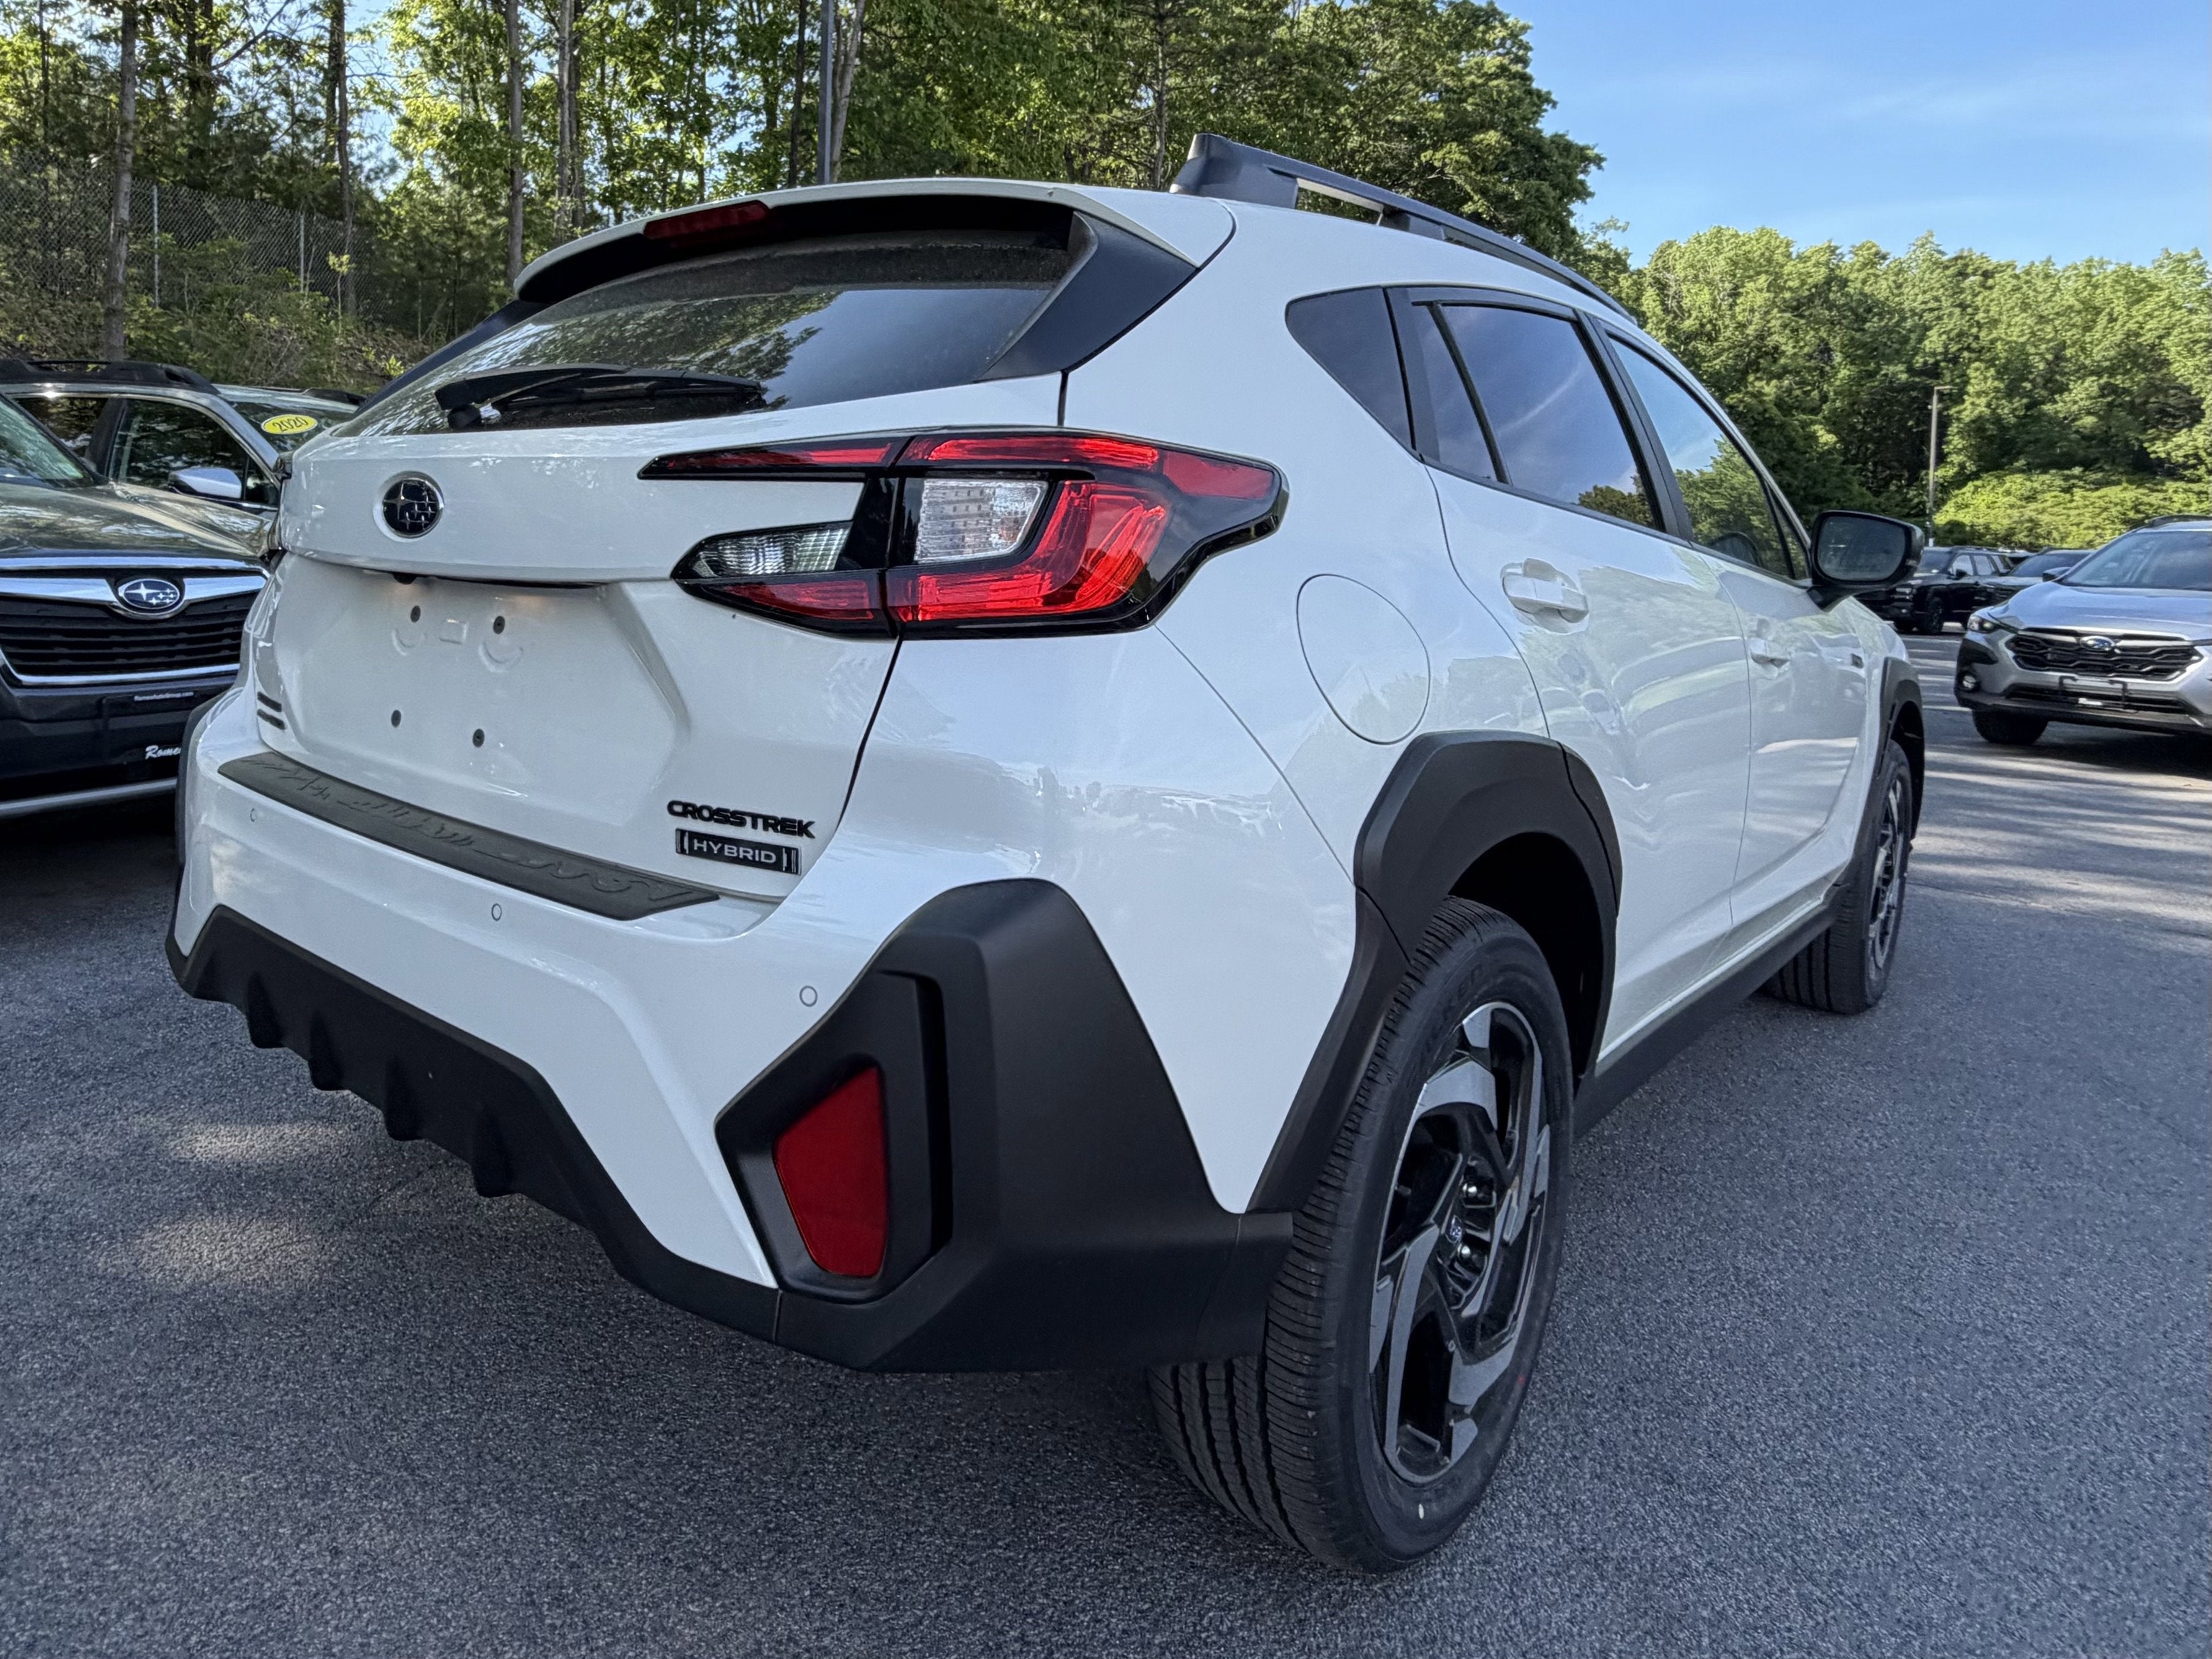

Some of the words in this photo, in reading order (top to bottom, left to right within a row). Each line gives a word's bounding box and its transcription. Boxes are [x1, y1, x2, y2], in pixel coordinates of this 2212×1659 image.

[272, 417, 309, 432] 2020
[667, 799, 815, 839] CROSSTREK
[693, 838, 776, 864] HYBRID
